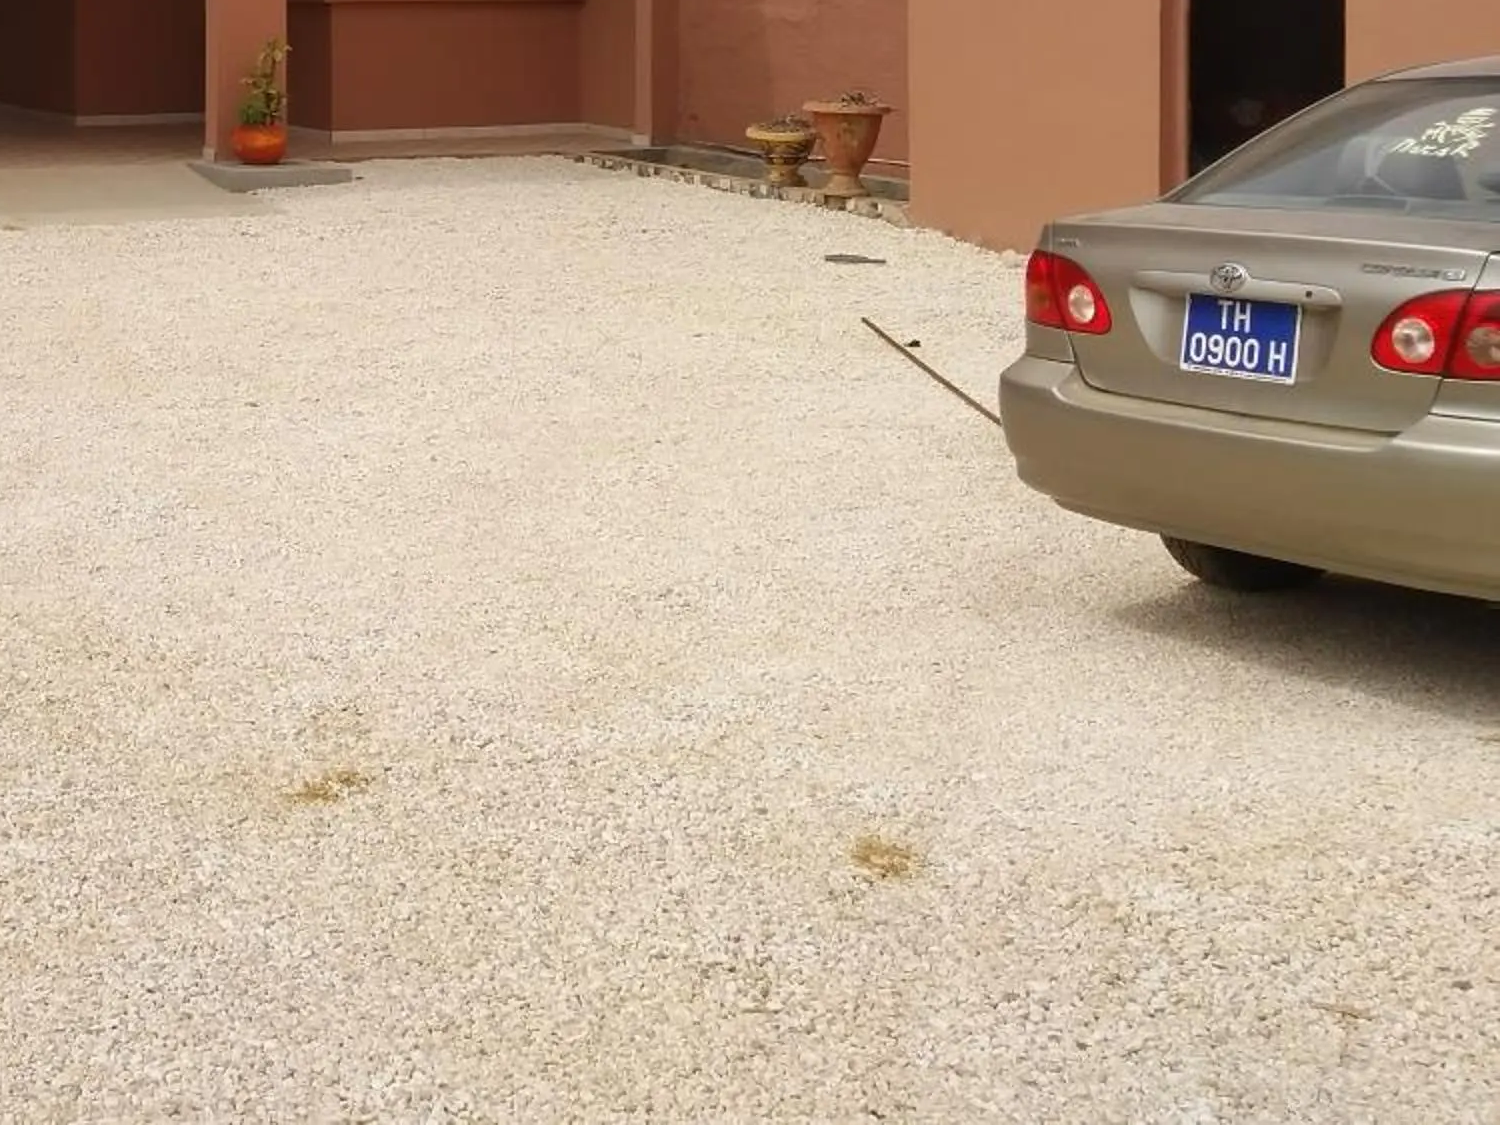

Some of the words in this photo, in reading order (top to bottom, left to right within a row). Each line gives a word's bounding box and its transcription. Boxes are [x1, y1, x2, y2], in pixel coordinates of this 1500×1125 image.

[1218, 299, 1251, 334] TH
[1189, 331, 1261, 370] 0900
[1267, 339, 1288, 374] H
